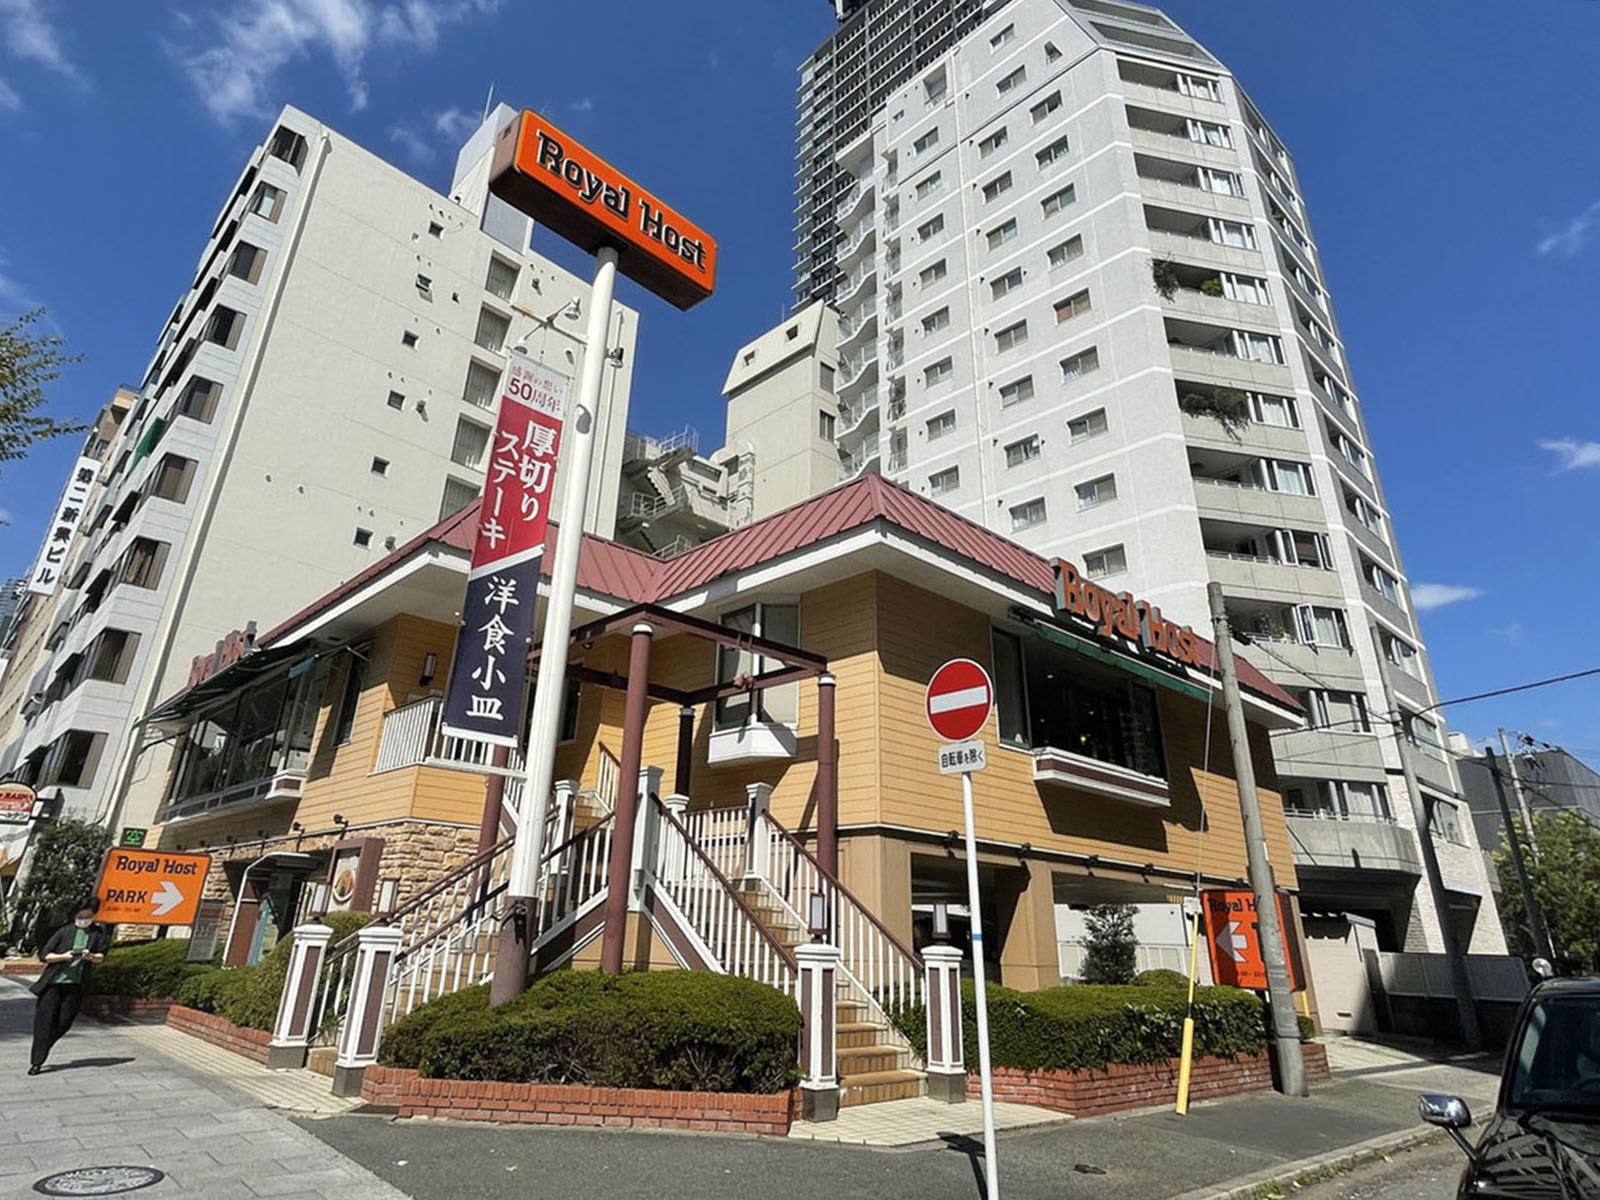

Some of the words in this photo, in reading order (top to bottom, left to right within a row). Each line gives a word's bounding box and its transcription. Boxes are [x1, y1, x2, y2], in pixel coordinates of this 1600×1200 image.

[536, 129, 631, 223] Royal
[639, 198, 706, 273] Host
[509, 377, 561, 412] 50周年
[481, 430, 520, 549] ステーキ
[521, 420, 557, 521] 厚切り
[1050, 557, 1140, 641] Royal
[466, 576, 519, 720] 洋食小皿
[941, 748, 984, 768] 自転車を除く
[105, 889, 148, 903] PARK
[116, 855, 160, 875] Royal
[163, 859, 198, 875] Host
